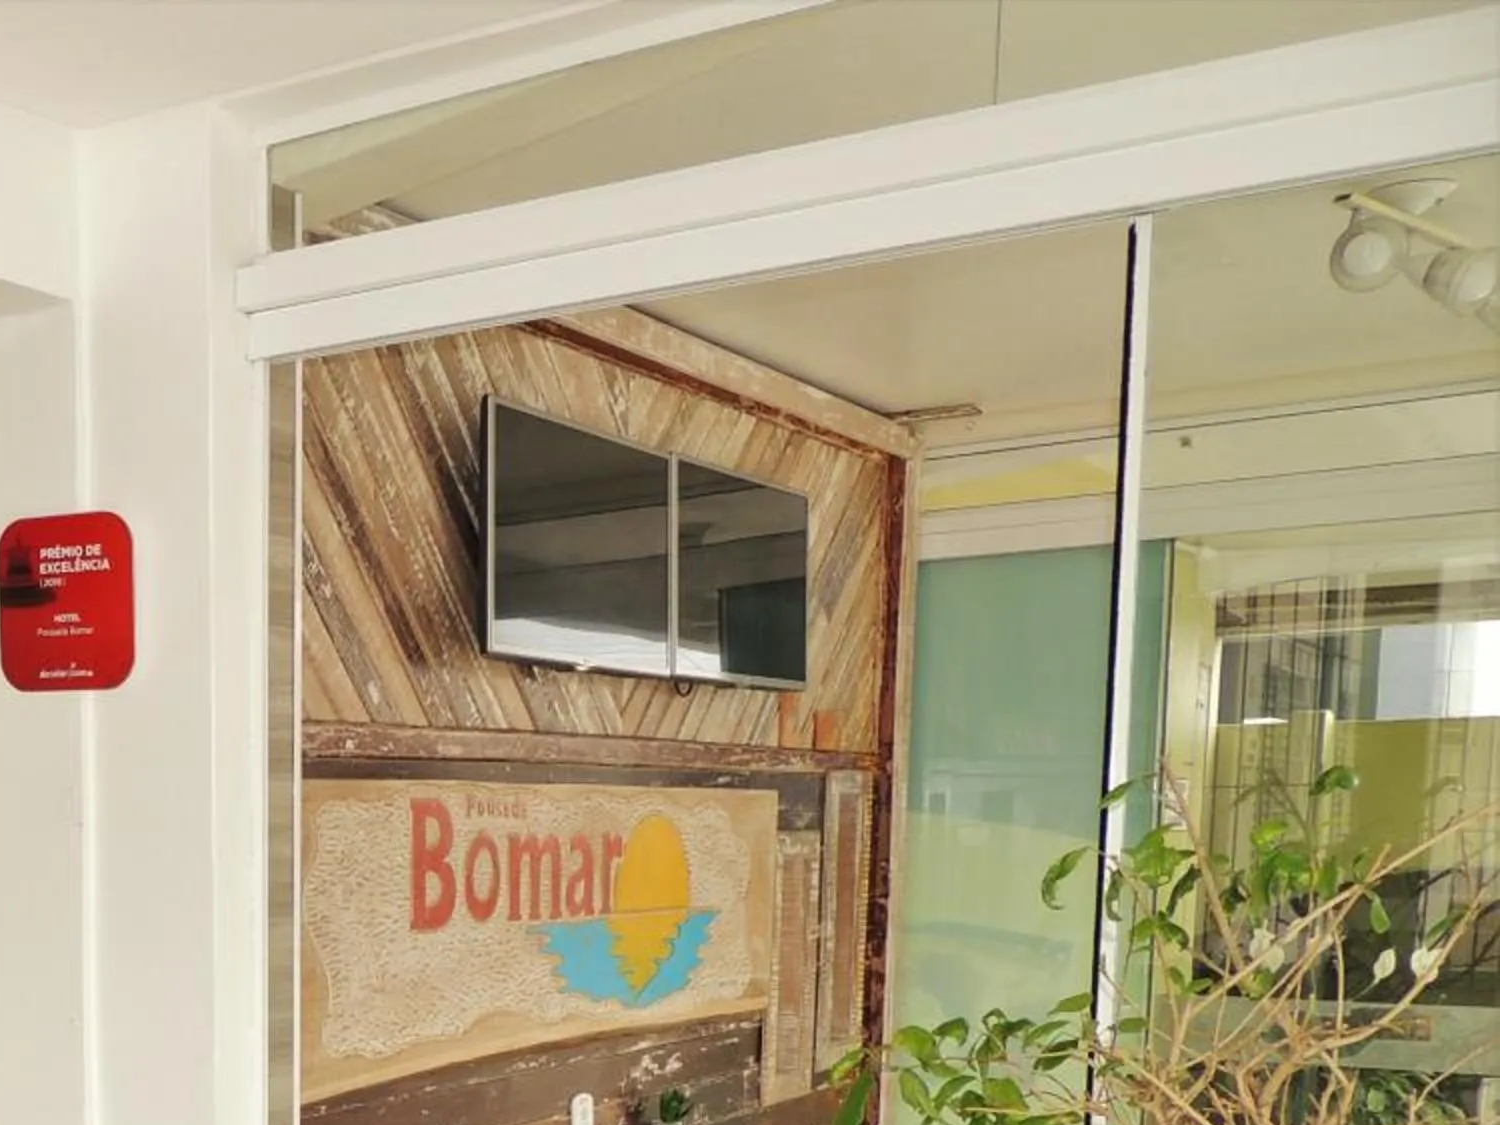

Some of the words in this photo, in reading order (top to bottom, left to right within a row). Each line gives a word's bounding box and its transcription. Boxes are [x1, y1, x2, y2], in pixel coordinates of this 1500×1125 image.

[86, 544, 101, 556] DE
[40, 558, 110, 574] EXCELÊNCIA
[410, 797, 625, 932] Bomar
